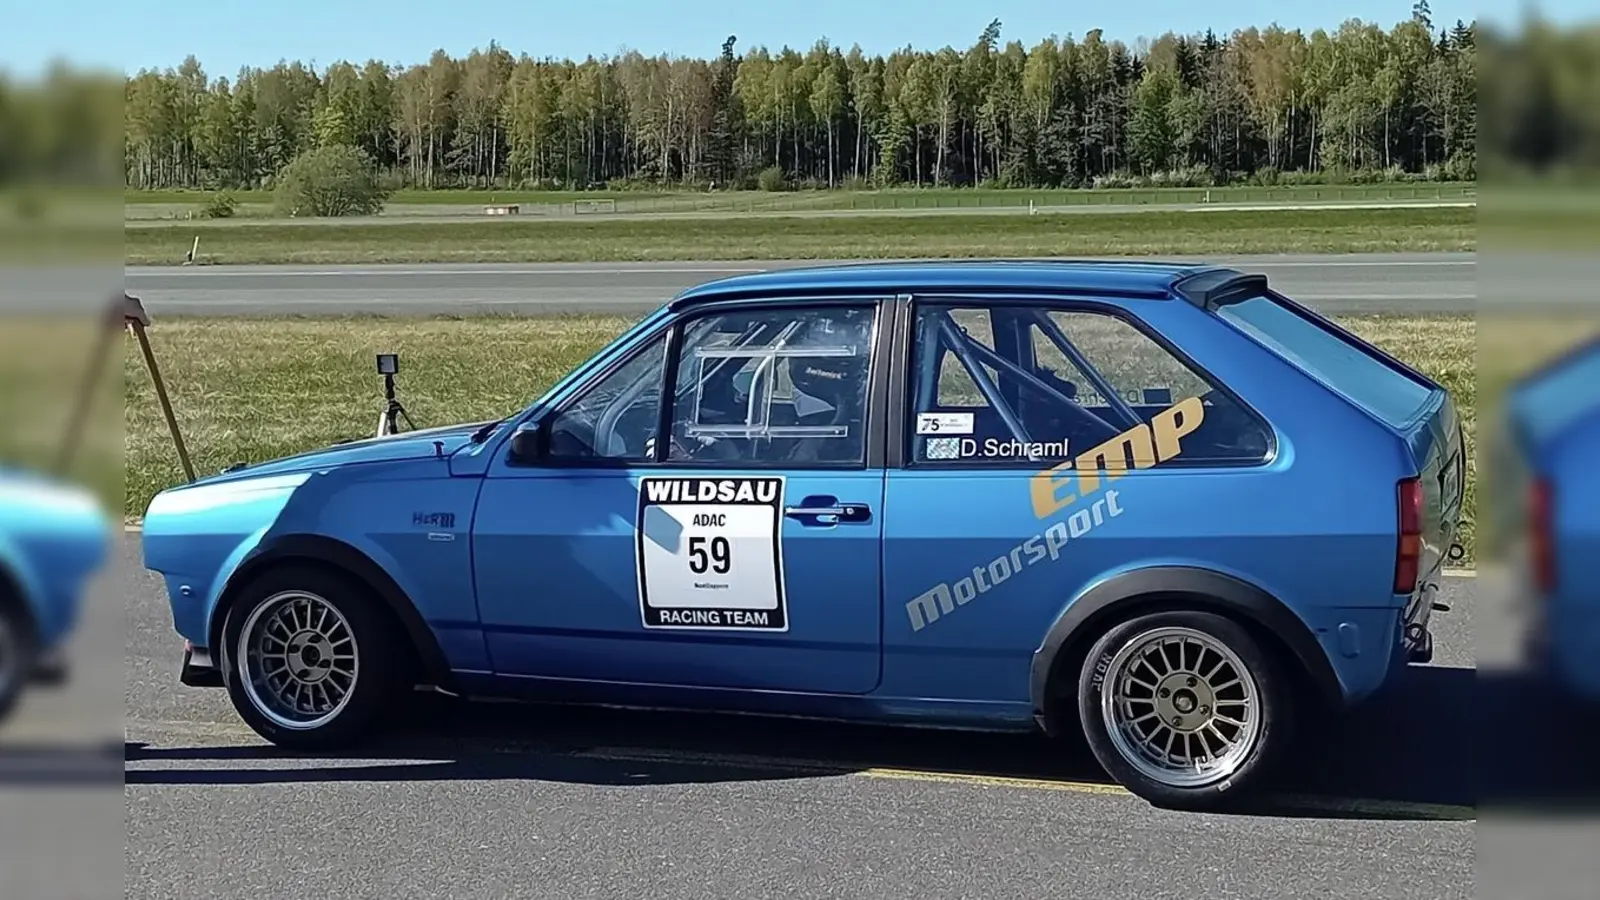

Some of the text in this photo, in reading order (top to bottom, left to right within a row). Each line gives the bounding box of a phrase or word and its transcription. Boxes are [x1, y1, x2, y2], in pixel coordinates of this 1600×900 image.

[920, 418, 940, 431] 75
[961, 438, 1068, 457] D.Schraml
[646, 480, 777, 502] WILDSAU
[693, 513, 727, 527] ADAC
[688, 535, 731, 574] 59
[660, 609, 769, 625] RACING TEAM
